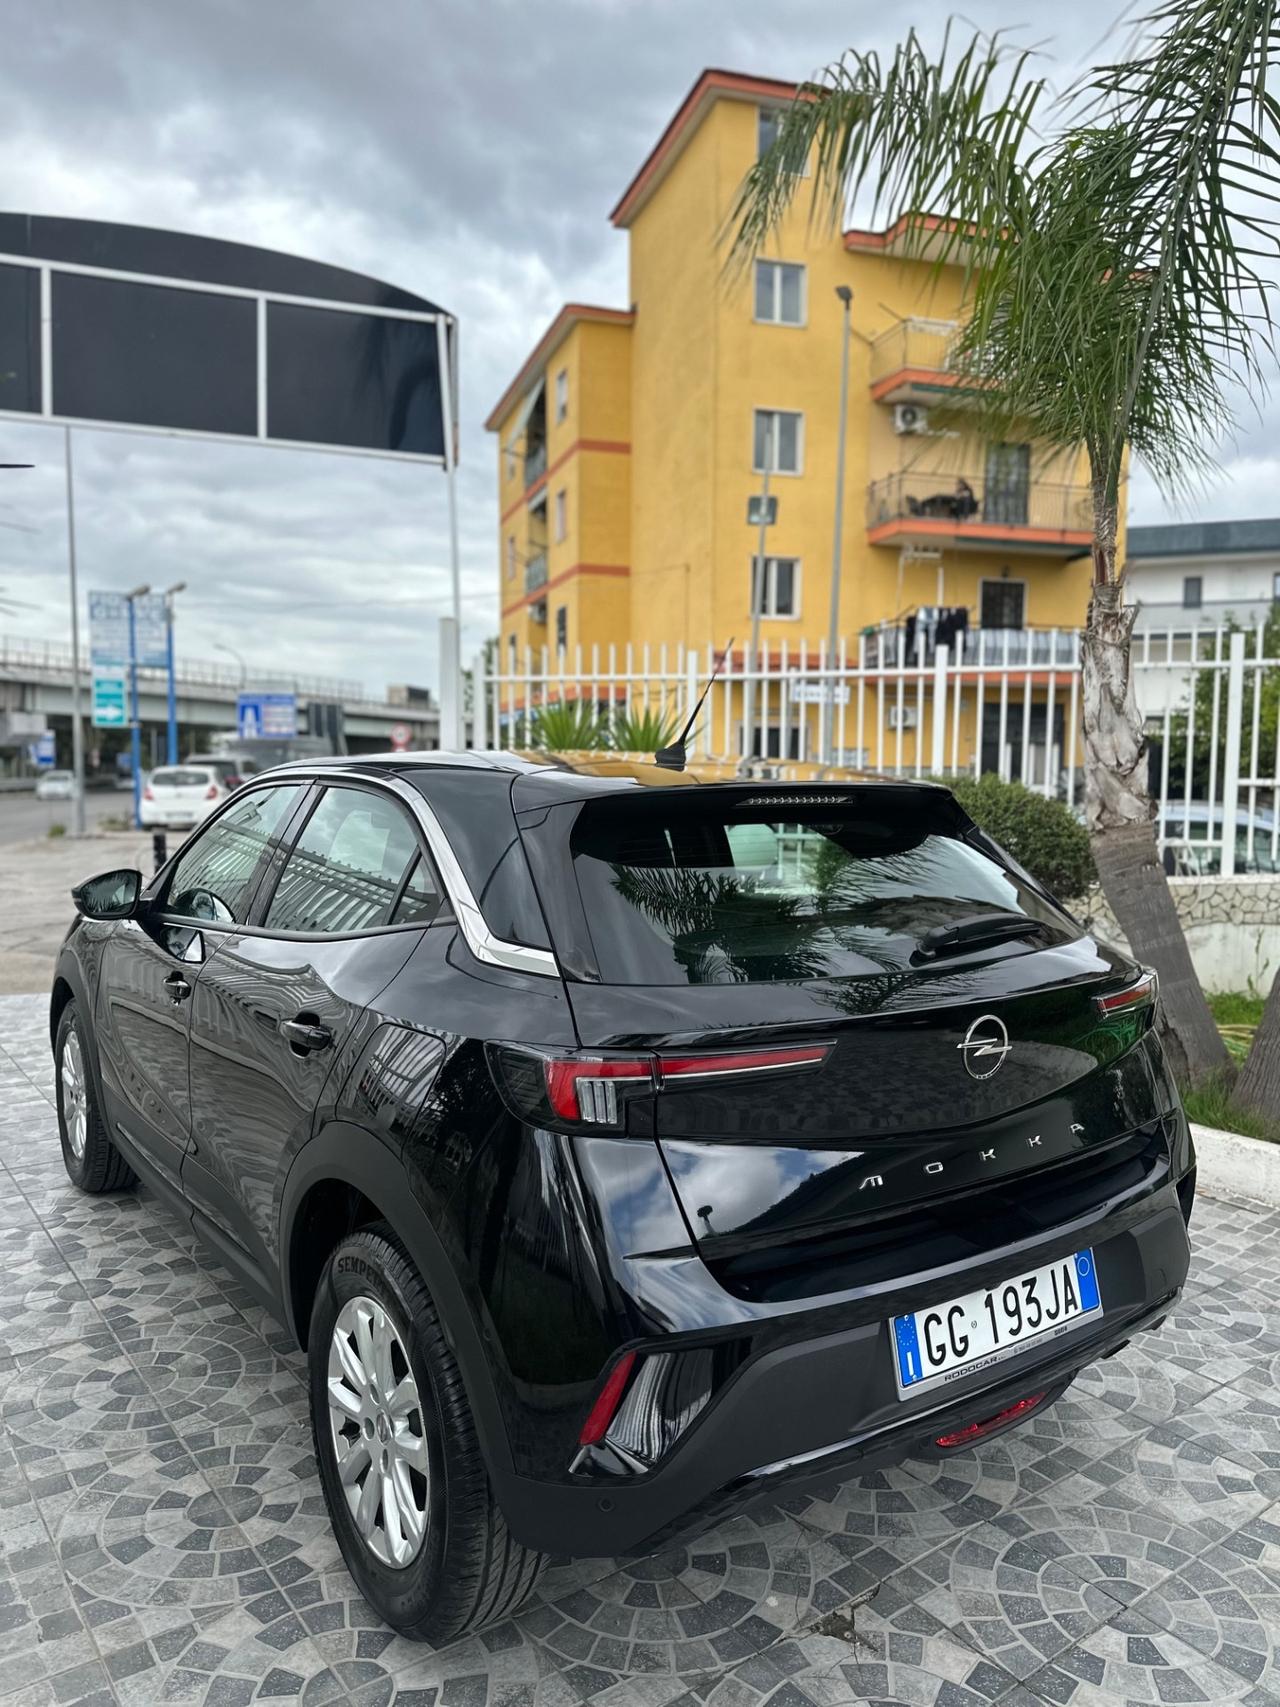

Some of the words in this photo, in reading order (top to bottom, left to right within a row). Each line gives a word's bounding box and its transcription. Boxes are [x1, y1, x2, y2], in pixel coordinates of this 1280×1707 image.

[858, 1123, 1085, 1190] MOKKA
[923, 1305, 969, 1367] GG
[984, 1264, 1079, 1344] 193JA
[944, 1356, 998, 1382] RODOCAR
